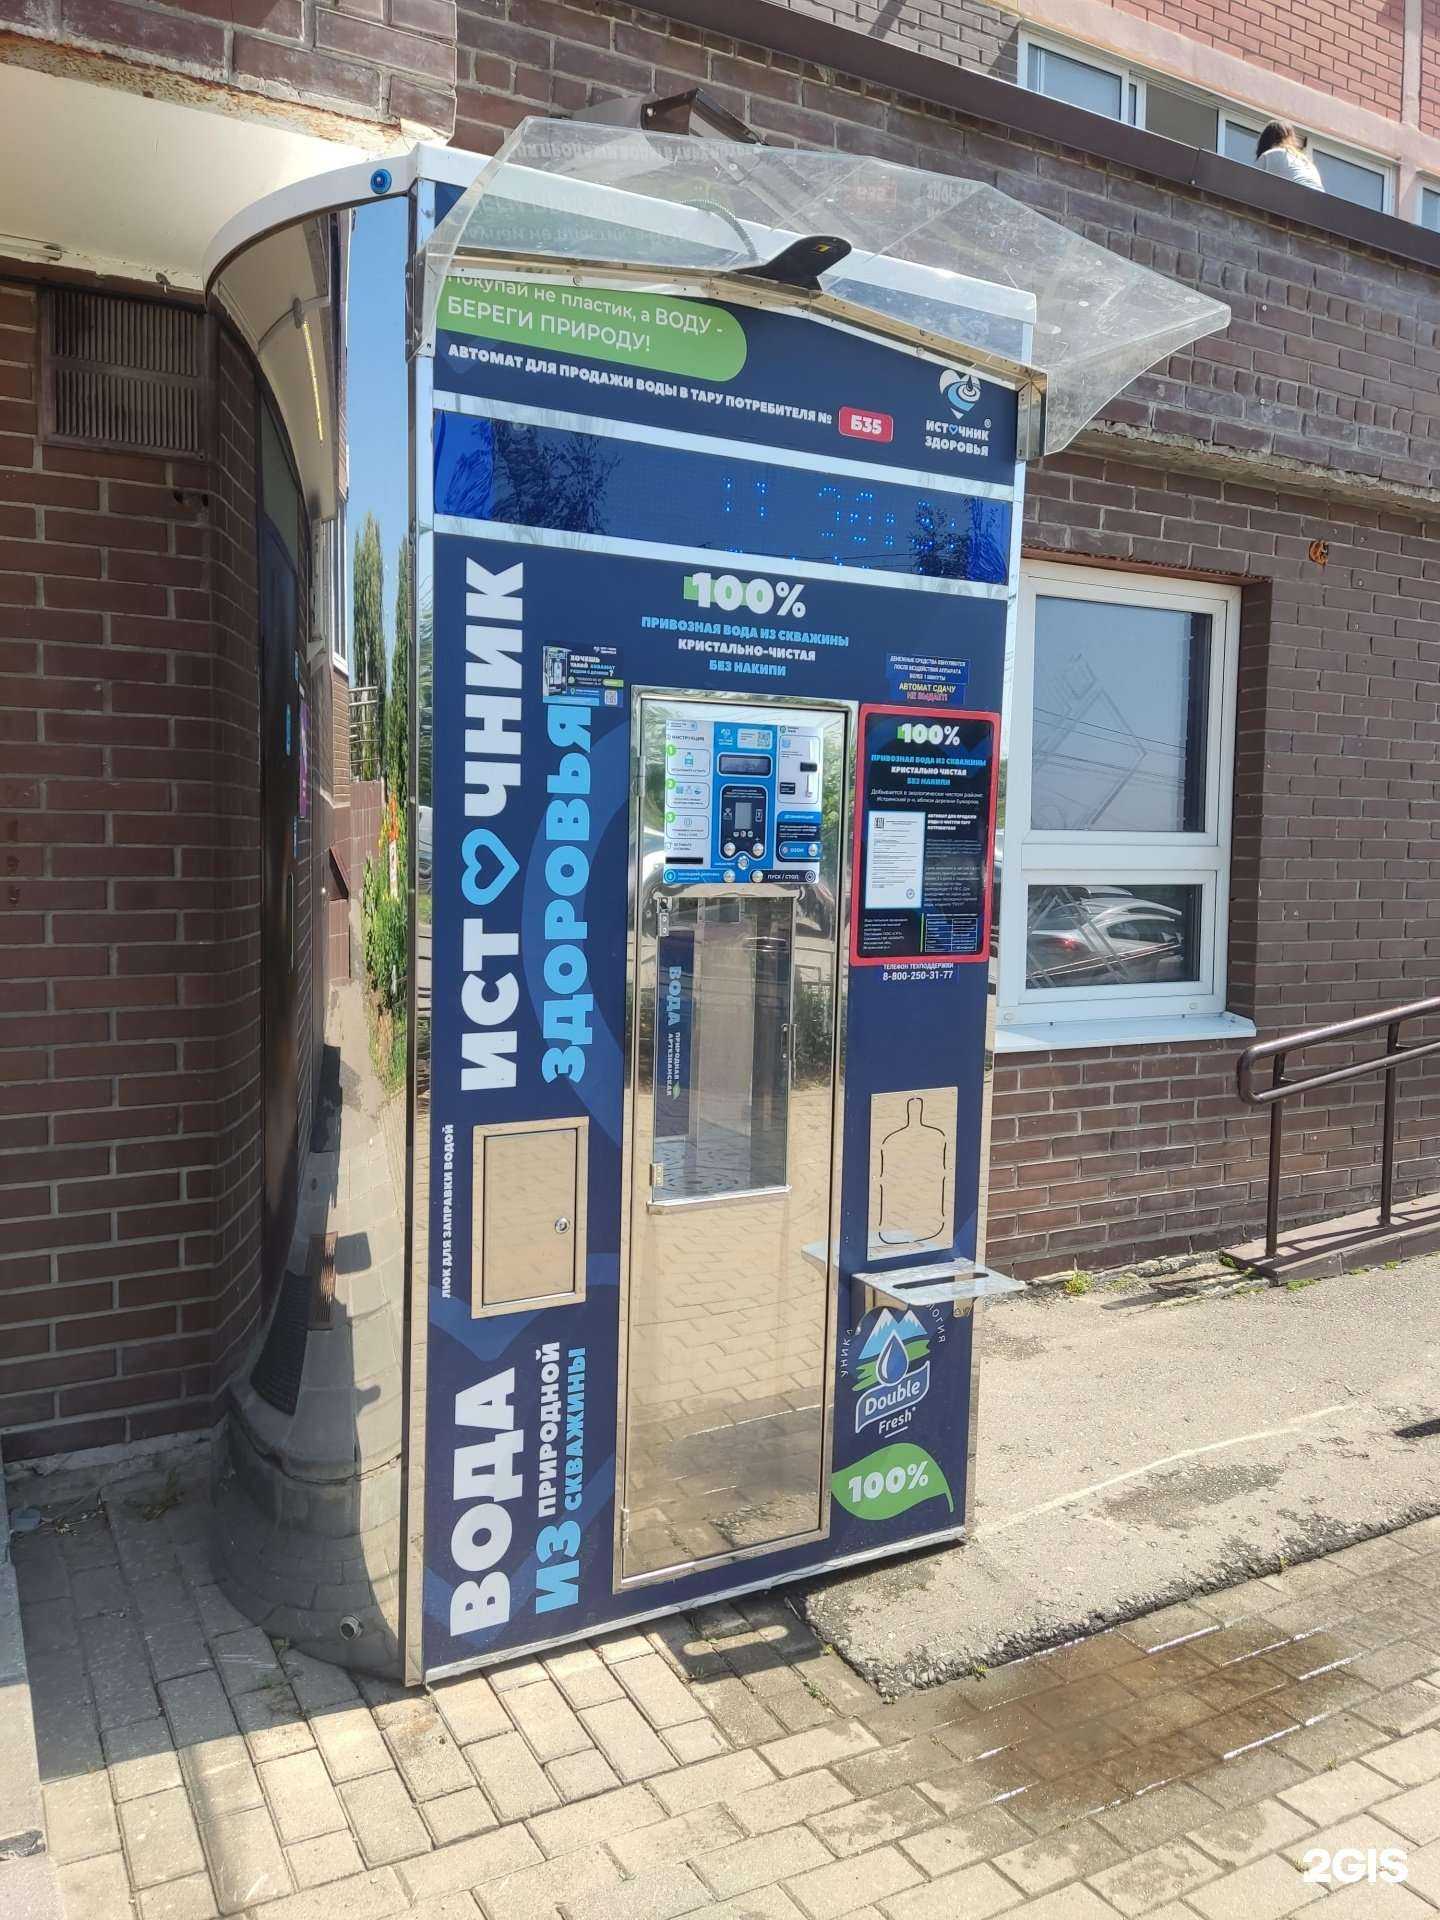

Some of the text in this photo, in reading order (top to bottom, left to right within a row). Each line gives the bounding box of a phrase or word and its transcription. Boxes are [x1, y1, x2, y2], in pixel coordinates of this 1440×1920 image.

[448, 296, 650, 352] БЕРЕГИ ПРИРОДУ!
[535, 288, 556, 302] не
[561, 293, 636, 322] пластик,
[640, 311, 650, 322] а
[656, 308, 711, 335] ВОДУ
[448, 344, 832, 424] АВТОМАТ ДЛЯ ПРОДАЖИ ВОДЫ В ТАРУ ПОТРЕБИТЕЛЯ №
[925, 436, 989, 457] ЗДОРОВЬЯ
[692, 572, 806, 618] 100%
[641, 616, 849, 646] ПРИВОЗНАЯ ВОДА ИЗ СКВАЖИНЫ
[678, 638, 816, 661] КРИСТАЛЬНО-ЧИСТАЯ
[709, 660, 786, 676] БЕЗ НАКИПИ
[899, 682, 956, 693] АВТОМАТ СДАЧУ
[902, 723, 960, 746] 100%
[871, 754, 914, 763] ПРИВОЗНАЯ
[915, 756, 935, 765] ВОДА
[946, 758, 986, 766] СКВАЖИНЫ
[891, 766, 967, 776] КРИСТАЛЬНО ЧИСТАЯ
[542, 703, 594, 1084] ЗДОРОВЬЯ
[666, 966, 682, 1026] ВОДА
[442, 1124, 455, 1298] ЛЮК ДЛЯ ЗАПРАВКИ ВОДОЙ
[864, 1379, 921, 1416] Double
[536, 1342, 560, 1517] ПРИРОДНОЙ
[450, 1366, 524, 1636] ВОДА
[536, 1348, 586, 1614] ИЗ СКВАЖИНЫ
[848, 1460, 929, 1504] 100%
